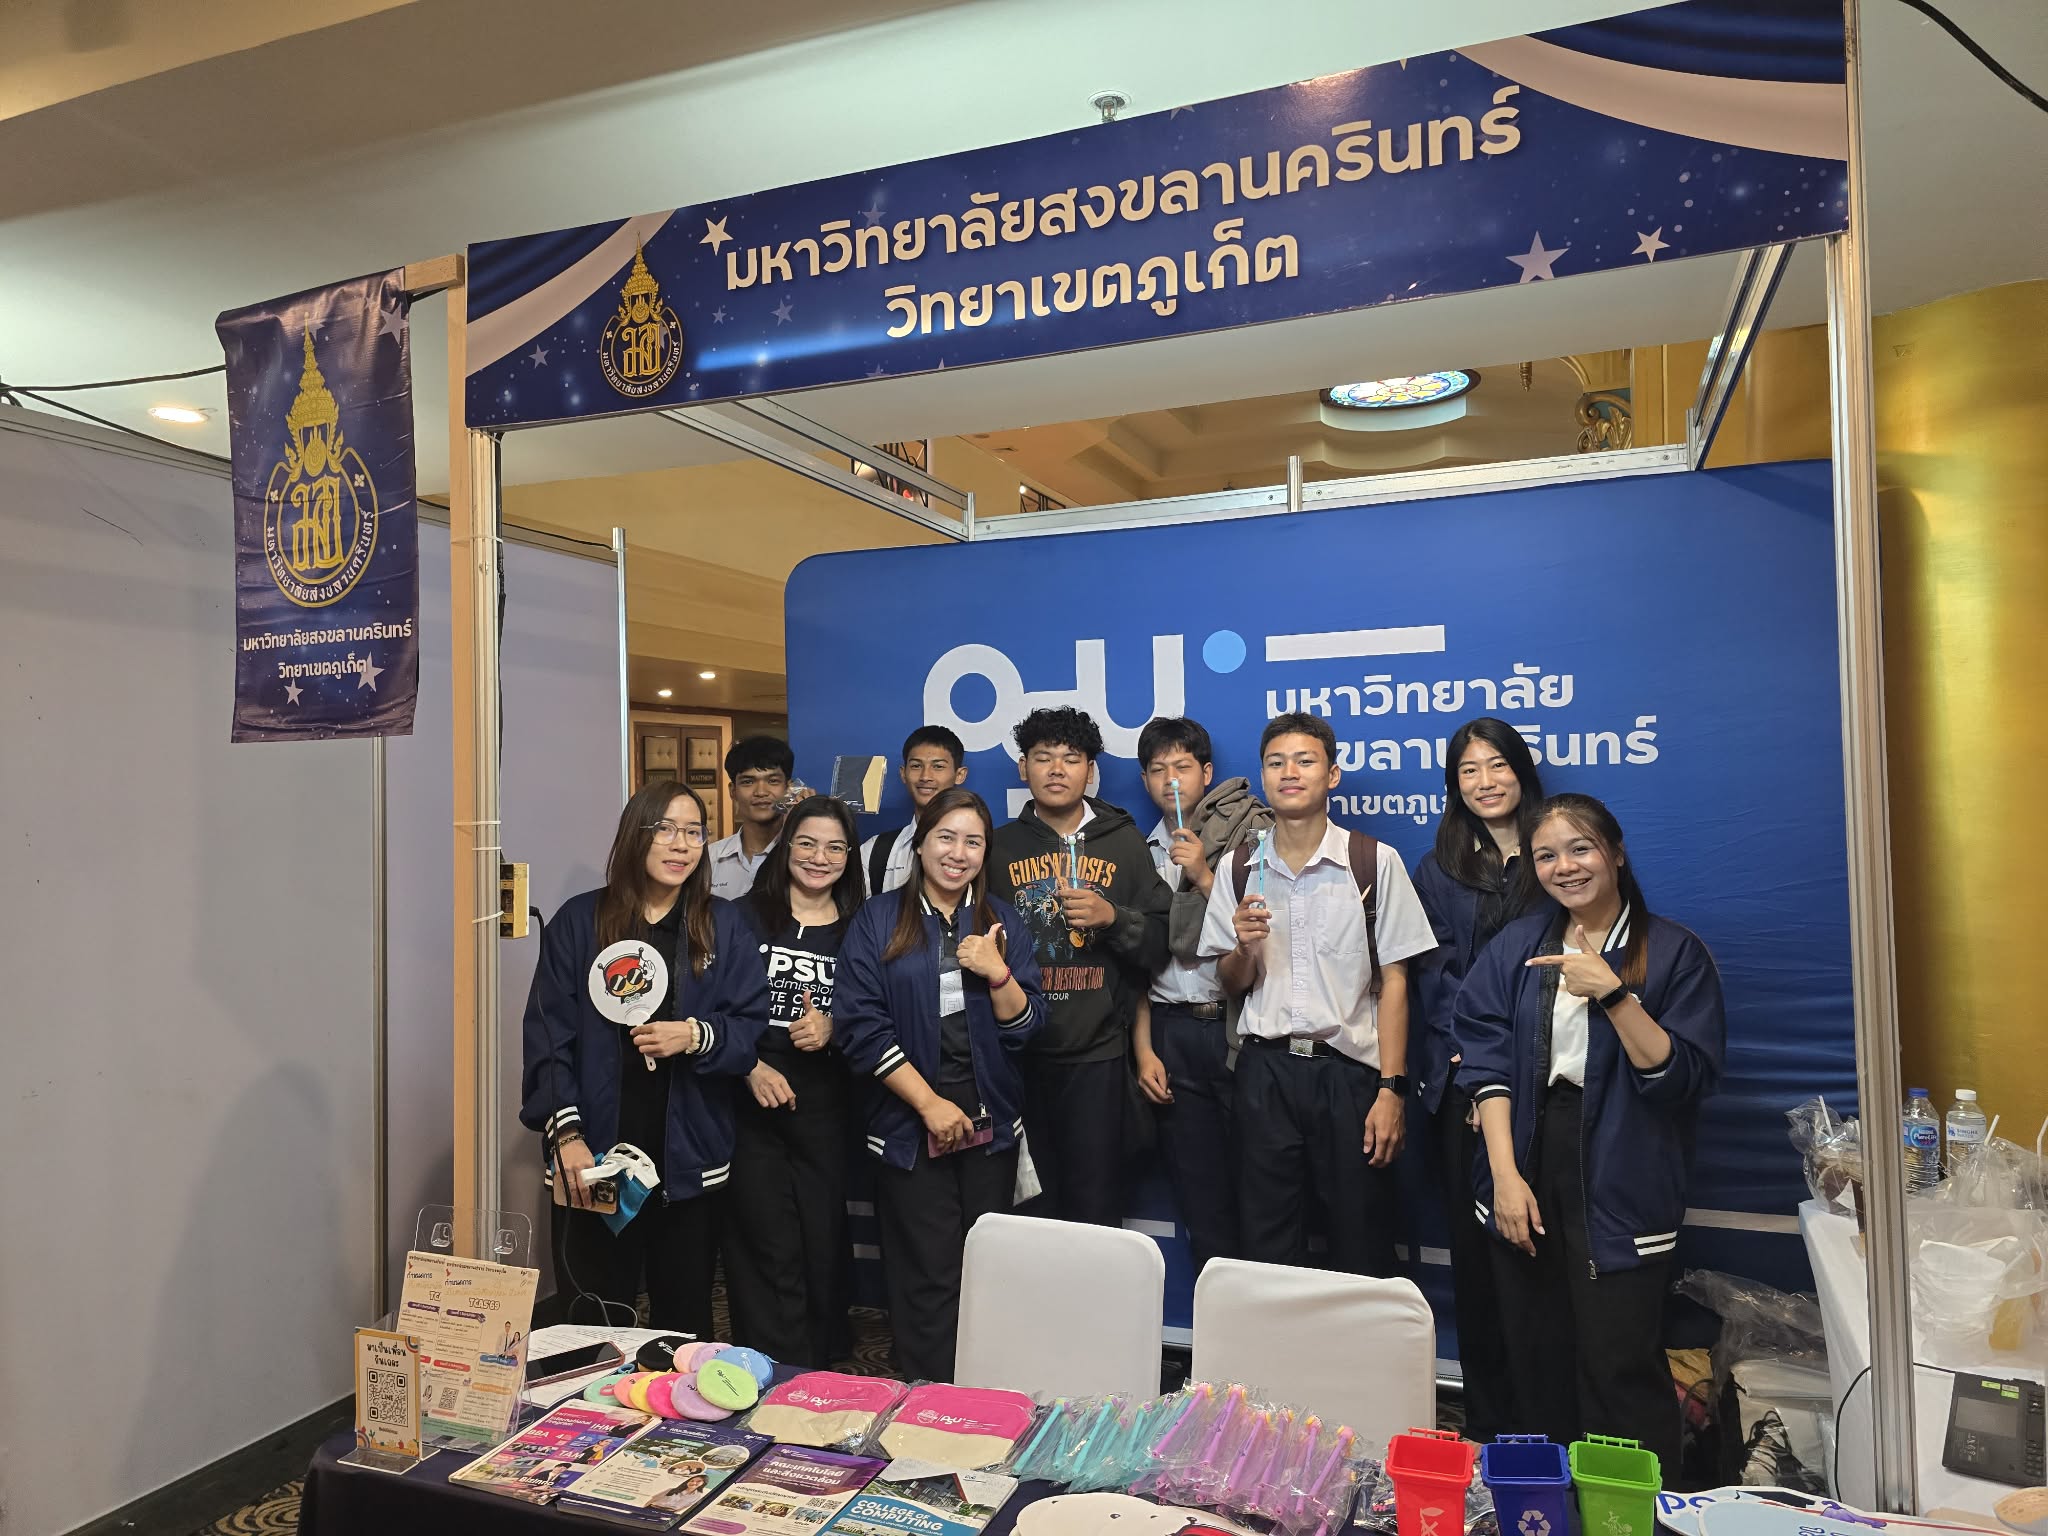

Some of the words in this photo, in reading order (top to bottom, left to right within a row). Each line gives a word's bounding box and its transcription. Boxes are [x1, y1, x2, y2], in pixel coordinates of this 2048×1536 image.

[725, 84, 1522, 291] มหาวิทยาลัยสงขลานครินทร์
[885, 217, 1300, 338] วิทยาเขตภูเก็ต
[243, 618, 412, 651] มหาวิทยาลัยสงขลานครินทร์
[278, 652, 367, 680] วิทยาเขตภูเก็ต
[1266, 662, 1574, 720] มหาวิทยาลัย
[1335, 715, 1659, 772] ขลารินทร์
[767, 952, 836, 986] PSU
[1048, 992, 1070, 1001] TOUR
[468, 1297, 501, 1311] TCAS'69
[527, 1429, 549, 1438] BBA
[590, 1423, 615, 1432] IHM
[559, 1450, 585, 1459] TAM
[850, 1506, 944, 1531] COMPUTING
[857, 1499, 916, 1517] COLLEGE
